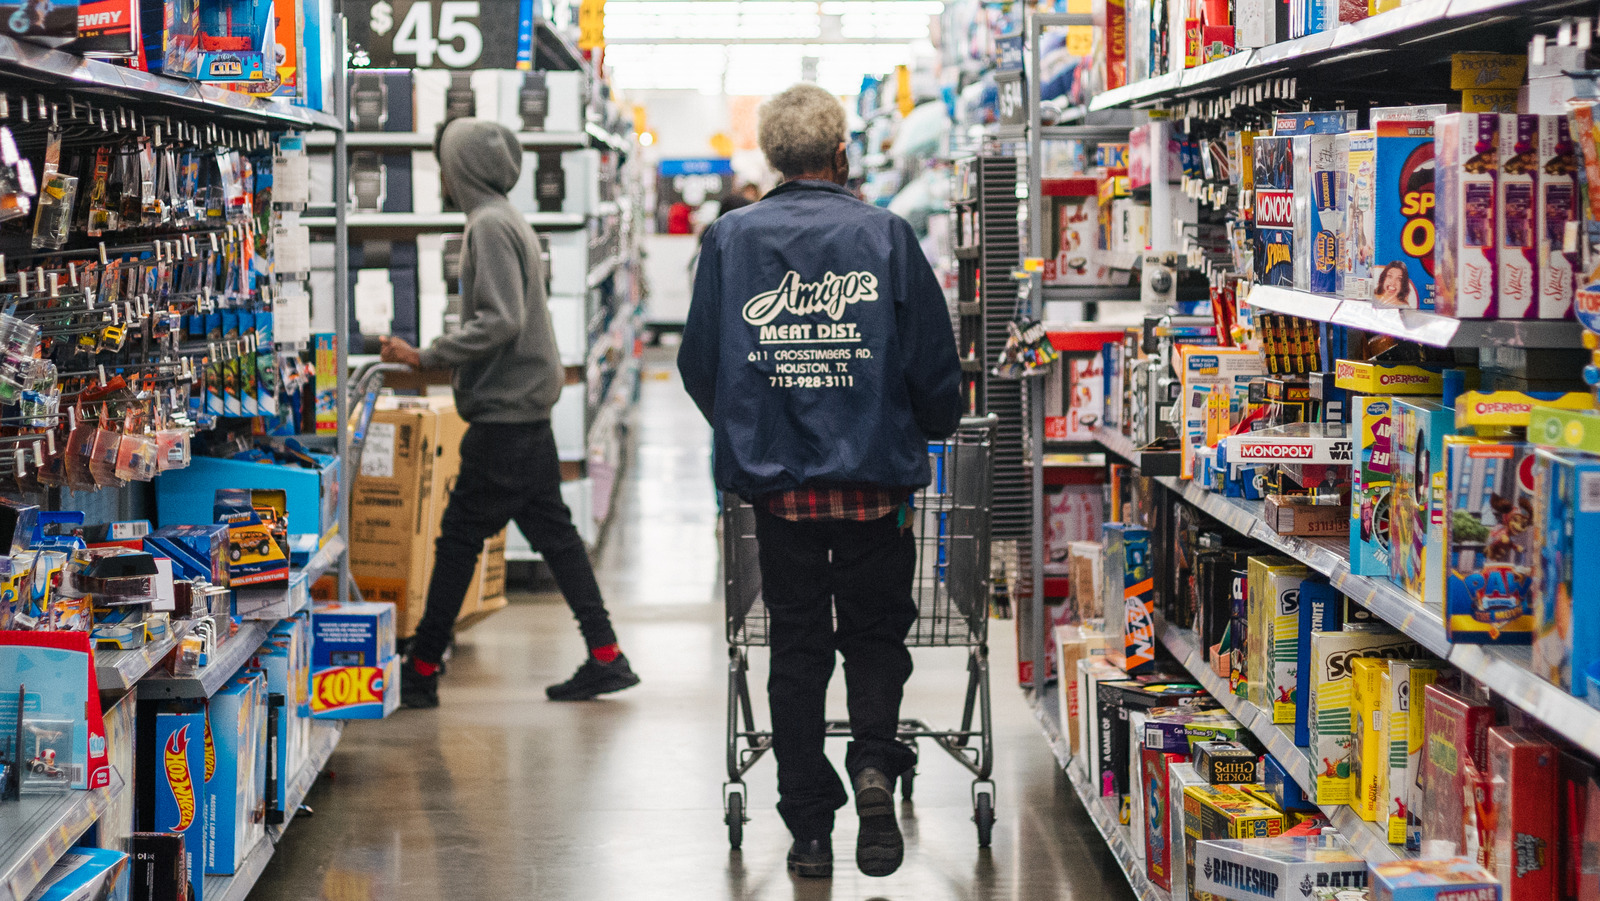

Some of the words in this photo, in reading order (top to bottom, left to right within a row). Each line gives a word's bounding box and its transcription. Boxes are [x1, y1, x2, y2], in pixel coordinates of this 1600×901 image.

[1112, 14, 1125, 55] CATAN
[210, 61, 242, 76] CITY
[1408, 128, 1426, 136] WITH
[1321, 172, 1329, 208] BLOCKBUSTER
[1315, 231, 1328, 272] FAMILY
[1325, 236, 1336, 265] FEUD
[742, 270, 879, 326] Amigos
[760, 324, 812, 340] MEAT
[817, 323, 861, 339] DIST.
[747, 350, 768, 362] 611
[774, 349, 851, 360] CROSSTIMBERS
[855, 348, 873, 359] RD.
[775, 363, 832, 374] HOUSTON,
[836, 362, 848, 372] TX
[769, 375, 853, 388] 713-928-3111
[1380, 374, 1430, 386] OPERATION
[1242, 446, 1312, 458] MONOPOLY
[1329, 451, 1352, 460] WA
[220, 511, 251, 522] ADVENTURE
[1308, 520, 1334, 532] FILES
[253, 573, 285, 582] ADVENTURE
[1465, 571, 1532, 598] PAW
[1126, 596, 1154, 660] NERF
[1102, 717, 1111, 729] OF
[1102, 730, 1111, 754] GAME
[1214, 761, 1254, 773] CHIPS
[1216, 773, 1252, 782] POKER
[1213, 857, 1278, 898] BATTLESHIP
